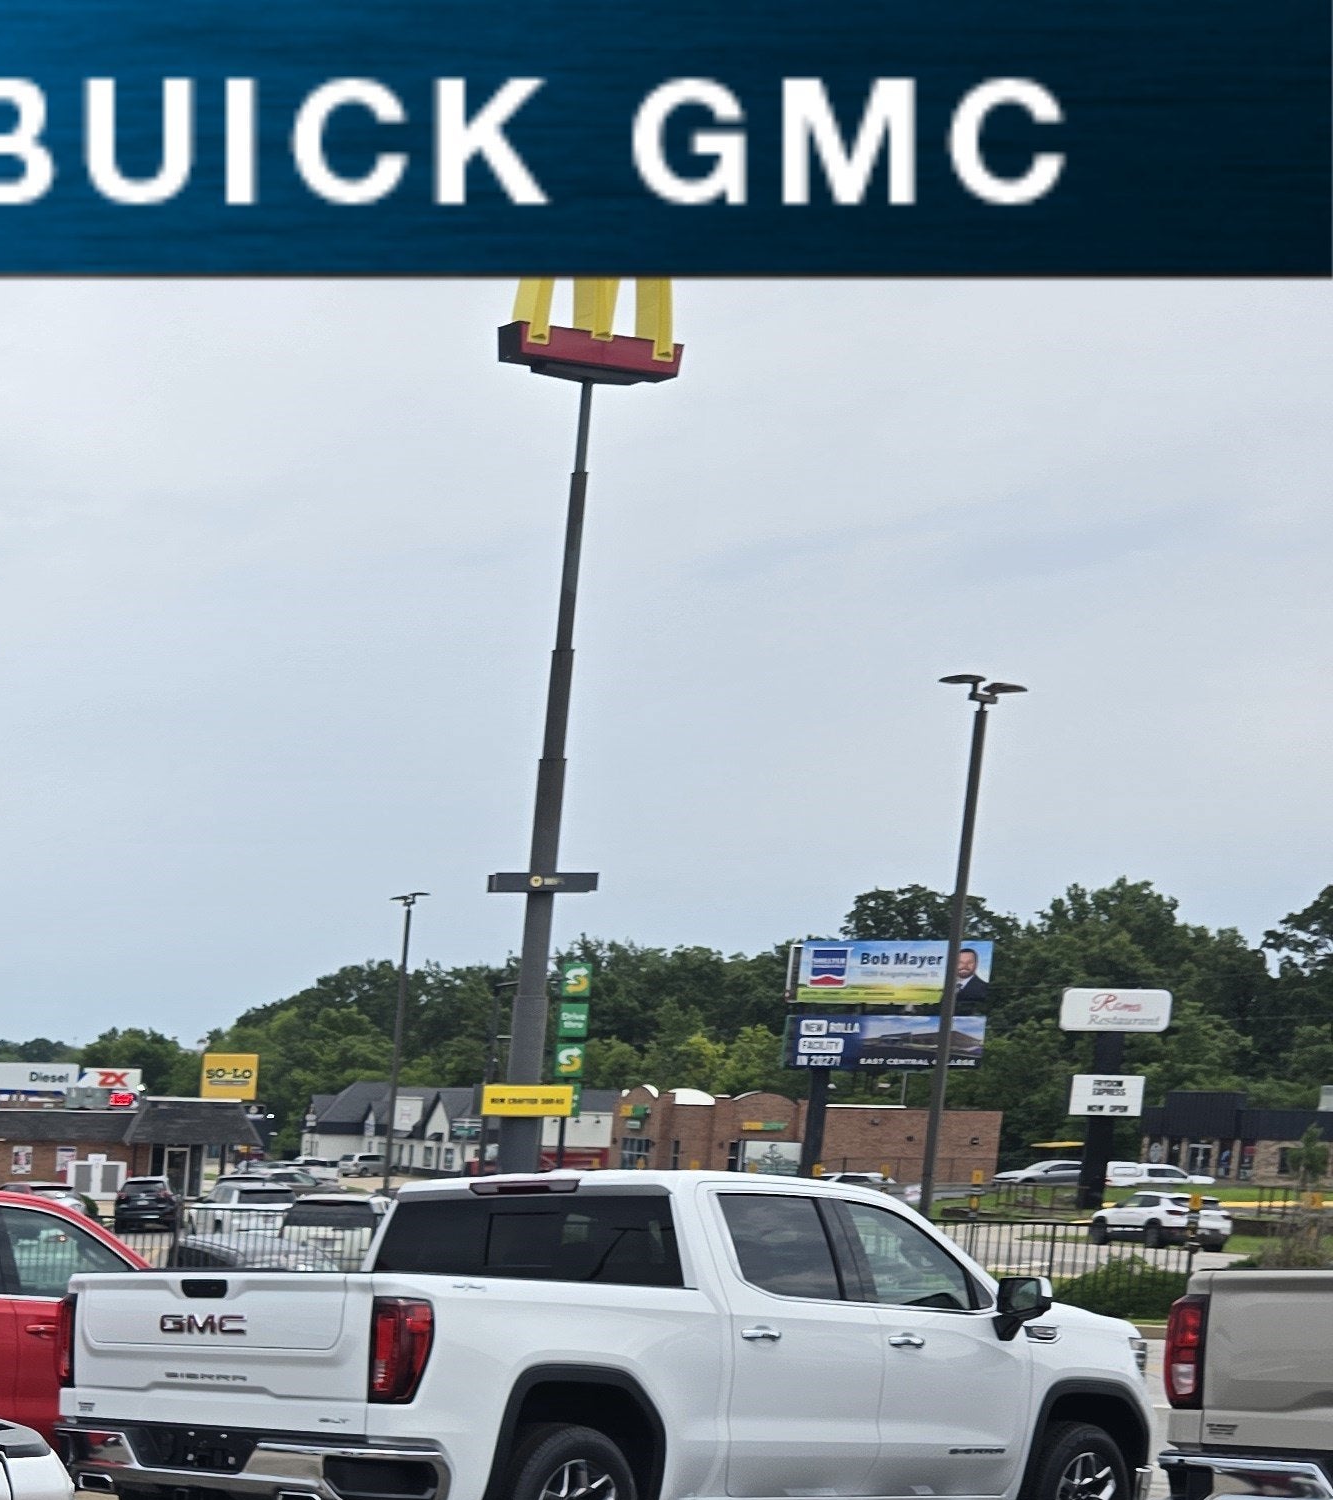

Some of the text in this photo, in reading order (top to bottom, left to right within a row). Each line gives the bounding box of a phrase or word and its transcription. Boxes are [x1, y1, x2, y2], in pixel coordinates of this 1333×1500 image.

[860, 952, 944, 969] Bob Mayer
[1087, 1015, 1160, 1026] Restaurant
[804, 1022, 860, 1034] NEW ROLLA
[802, 1041, 840, 1051] FACILITY
[859, 1057, 884, 1066] EAST
[886, 1058, 929, 1066] CENTRAL
[28, 1071, 69, 1083] Diesel
[205, 1068, 252, 1079] SO-LO
[97, 1072, 129, 1087] ZX
[159, 1313, 247, 1335] GMC
[164, 1371, 248, 1382] SIERRA
